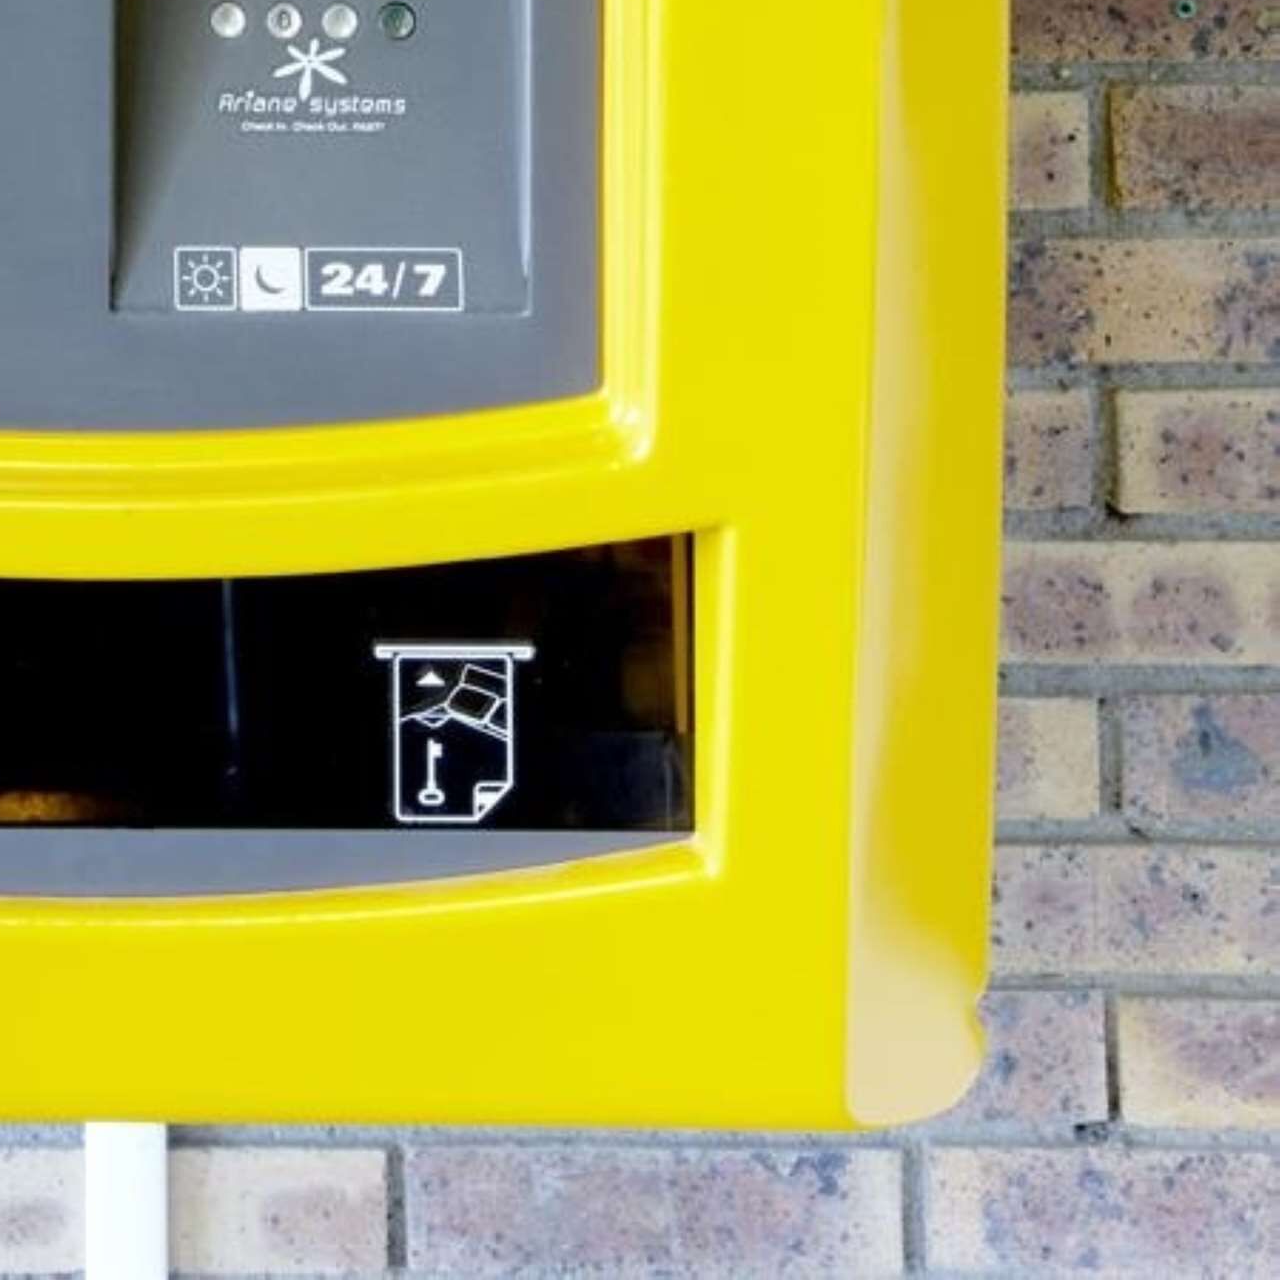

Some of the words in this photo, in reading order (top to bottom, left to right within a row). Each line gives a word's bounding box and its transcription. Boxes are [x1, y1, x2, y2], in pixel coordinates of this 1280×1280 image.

[277, 9, 293, 31] 0
[218, 90, 298, 113] Ariane
[308, 95, 407, 117] systems
[319, 260, 448, 300] 24/7
